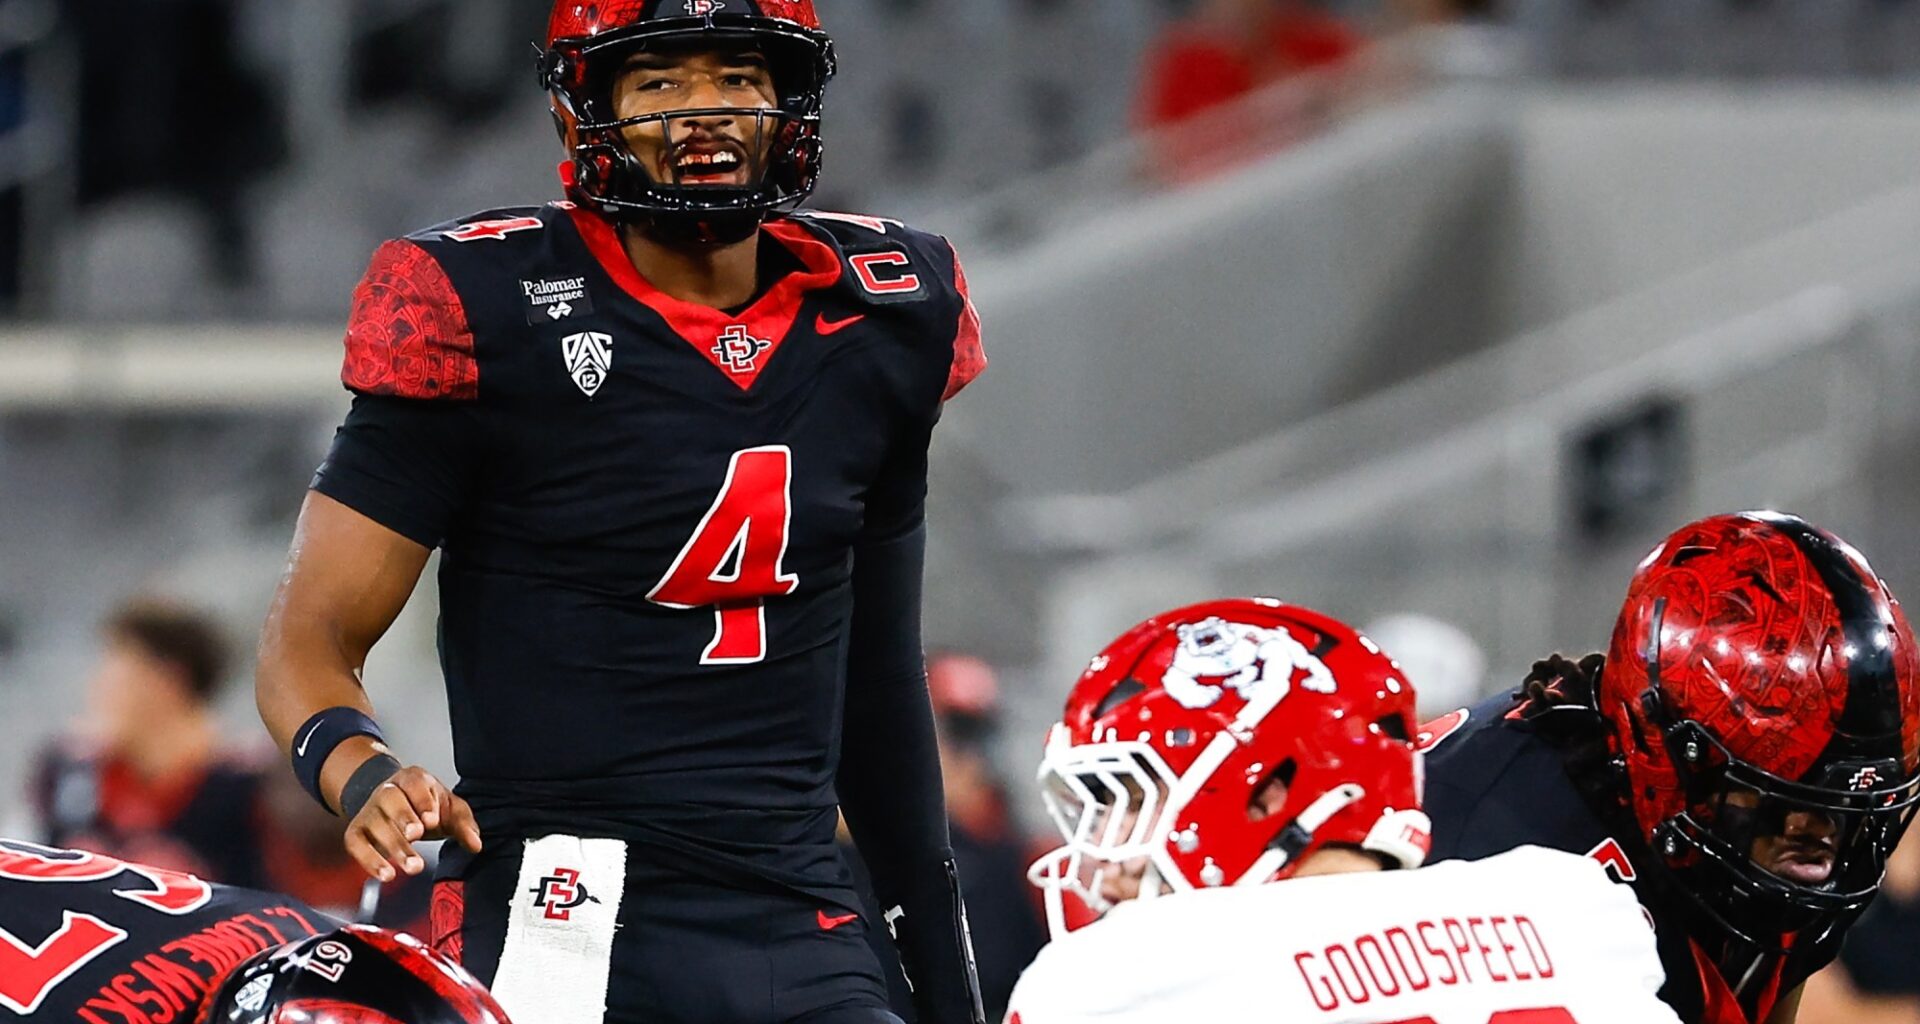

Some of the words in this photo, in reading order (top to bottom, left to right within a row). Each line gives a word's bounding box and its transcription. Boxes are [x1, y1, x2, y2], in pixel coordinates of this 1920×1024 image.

[522, 277, 585, 296] Palomar
[849, 251, 920, 294] C
[530, 289, 584, 305] Insurance
[562, 332, 613, 373] PAC
[582, 374, 597, 388] 12
[645, 445, 800, 665] 4
[304, 941, 353, 983] 67
[1294, 914, 1554, 1012] GOODSPEED
